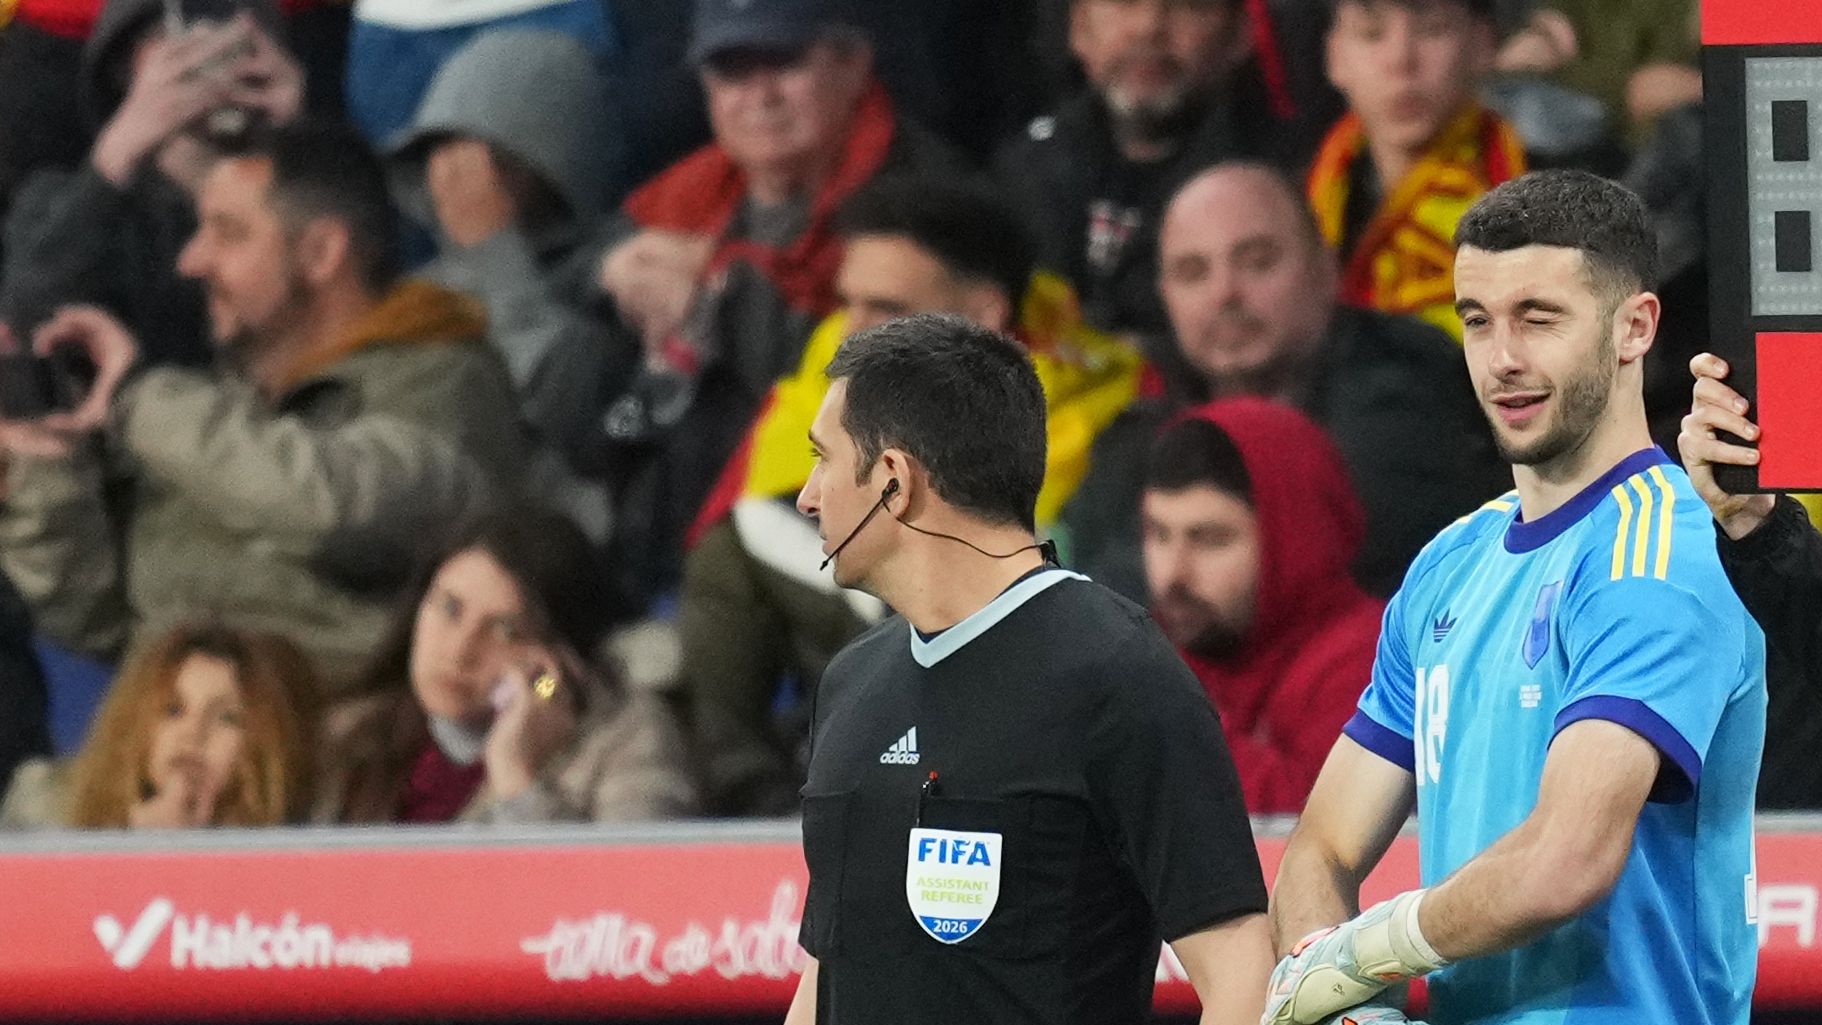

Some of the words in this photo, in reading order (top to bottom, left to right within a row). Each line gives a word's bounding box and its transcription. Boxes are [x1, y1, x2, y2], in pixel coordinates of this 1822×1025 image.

[1414, 664, 1449, 786] 18
[880, 749, 920, 765] adidas
[918, 838, 991, 866] FIFA
[916, 877, 989, 891] ASSISTANT
[921, 890, 983, 904] REFEREE
[933, 920, 968, 933] 2026
[171, 911, 332, 969] Halcón
